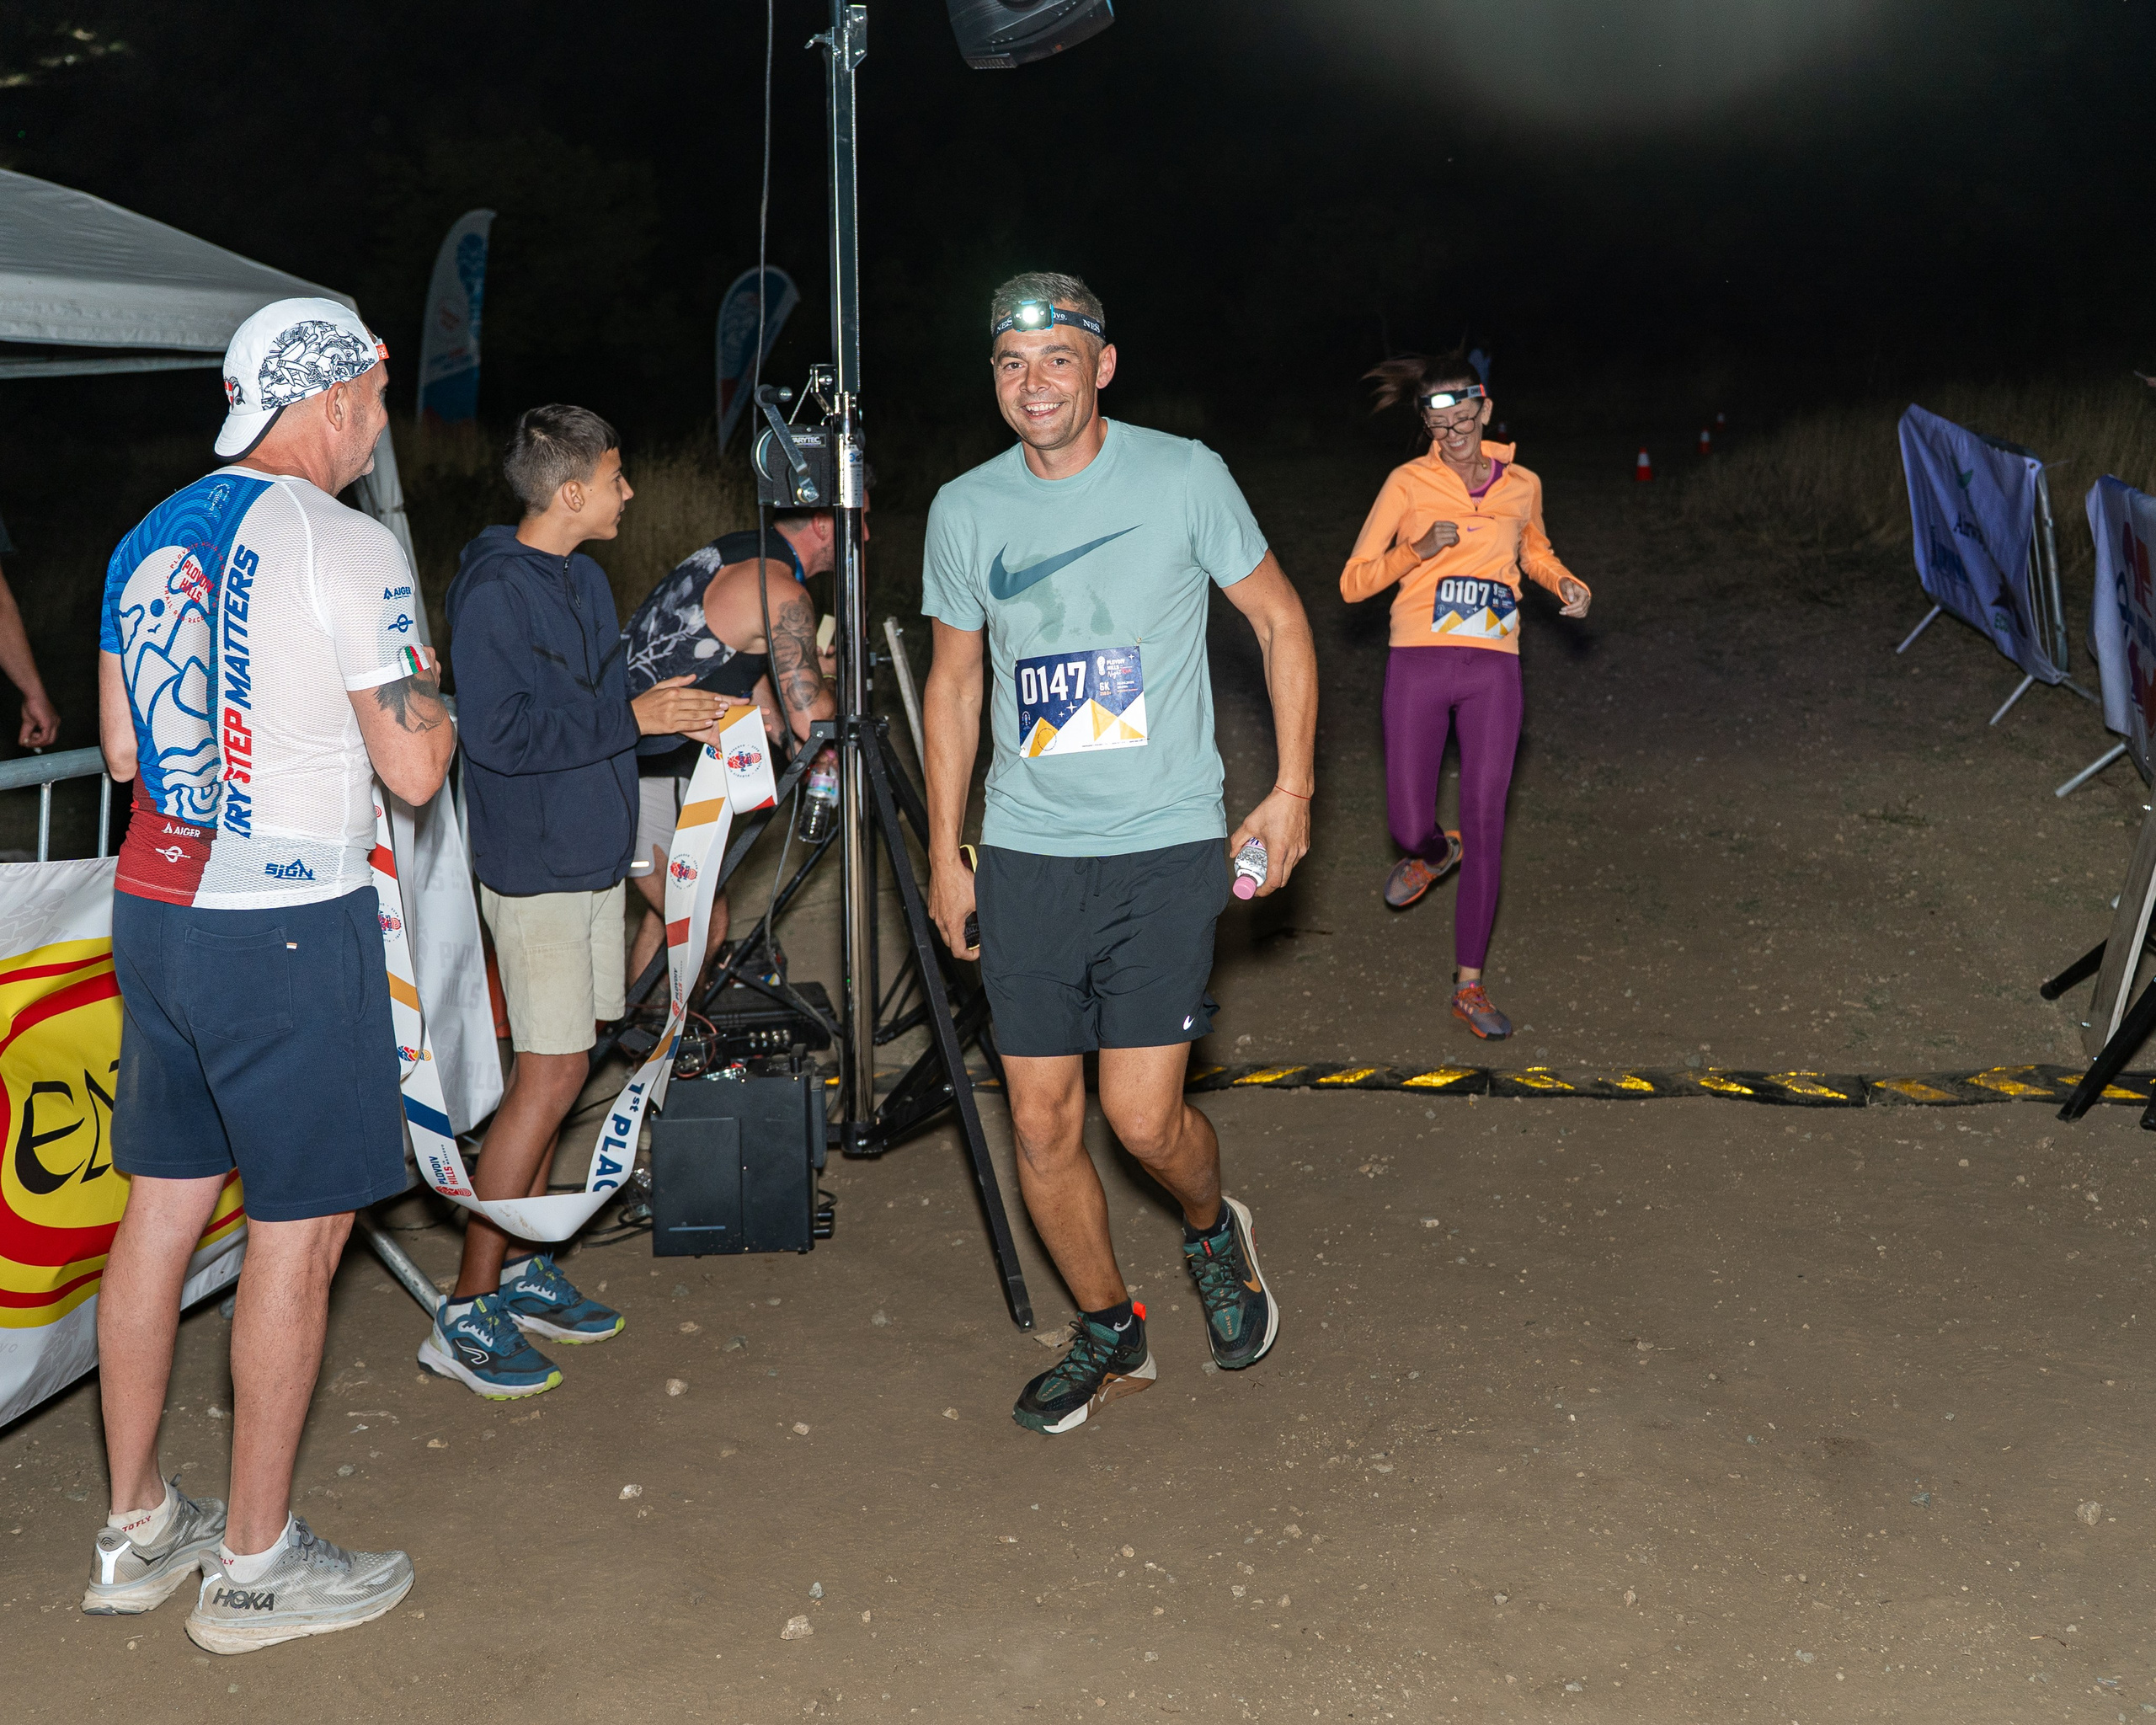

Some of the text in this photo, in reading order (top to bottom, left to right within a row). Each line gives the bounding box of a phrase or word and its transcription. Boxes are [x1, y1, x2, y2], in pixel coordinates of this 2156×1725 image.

[179, 577, 203, 604] HILLS
[182, 559, 216, 594] PLOVDIV
[1440, 579, 1491, 606] 0107
[223, 543, 259, 710] MATTERS
[1020, 660, 1087, 706] 0147
[1099, 681, 1111, 692] 6K
[223, 707, 253, 784] STEP
[223, 780, 253, 839] RY
[173, 825, 201, 838] AIGER
[627, 1082, 646, 1113] 1st
[428, 1156, 449, 1185] PLOVDIV
[443, 1166, 459, 1185] HILLS
[122, 1515, 152, 1532] TO FLY
[212, 1587, 275, 1611] HOKA
